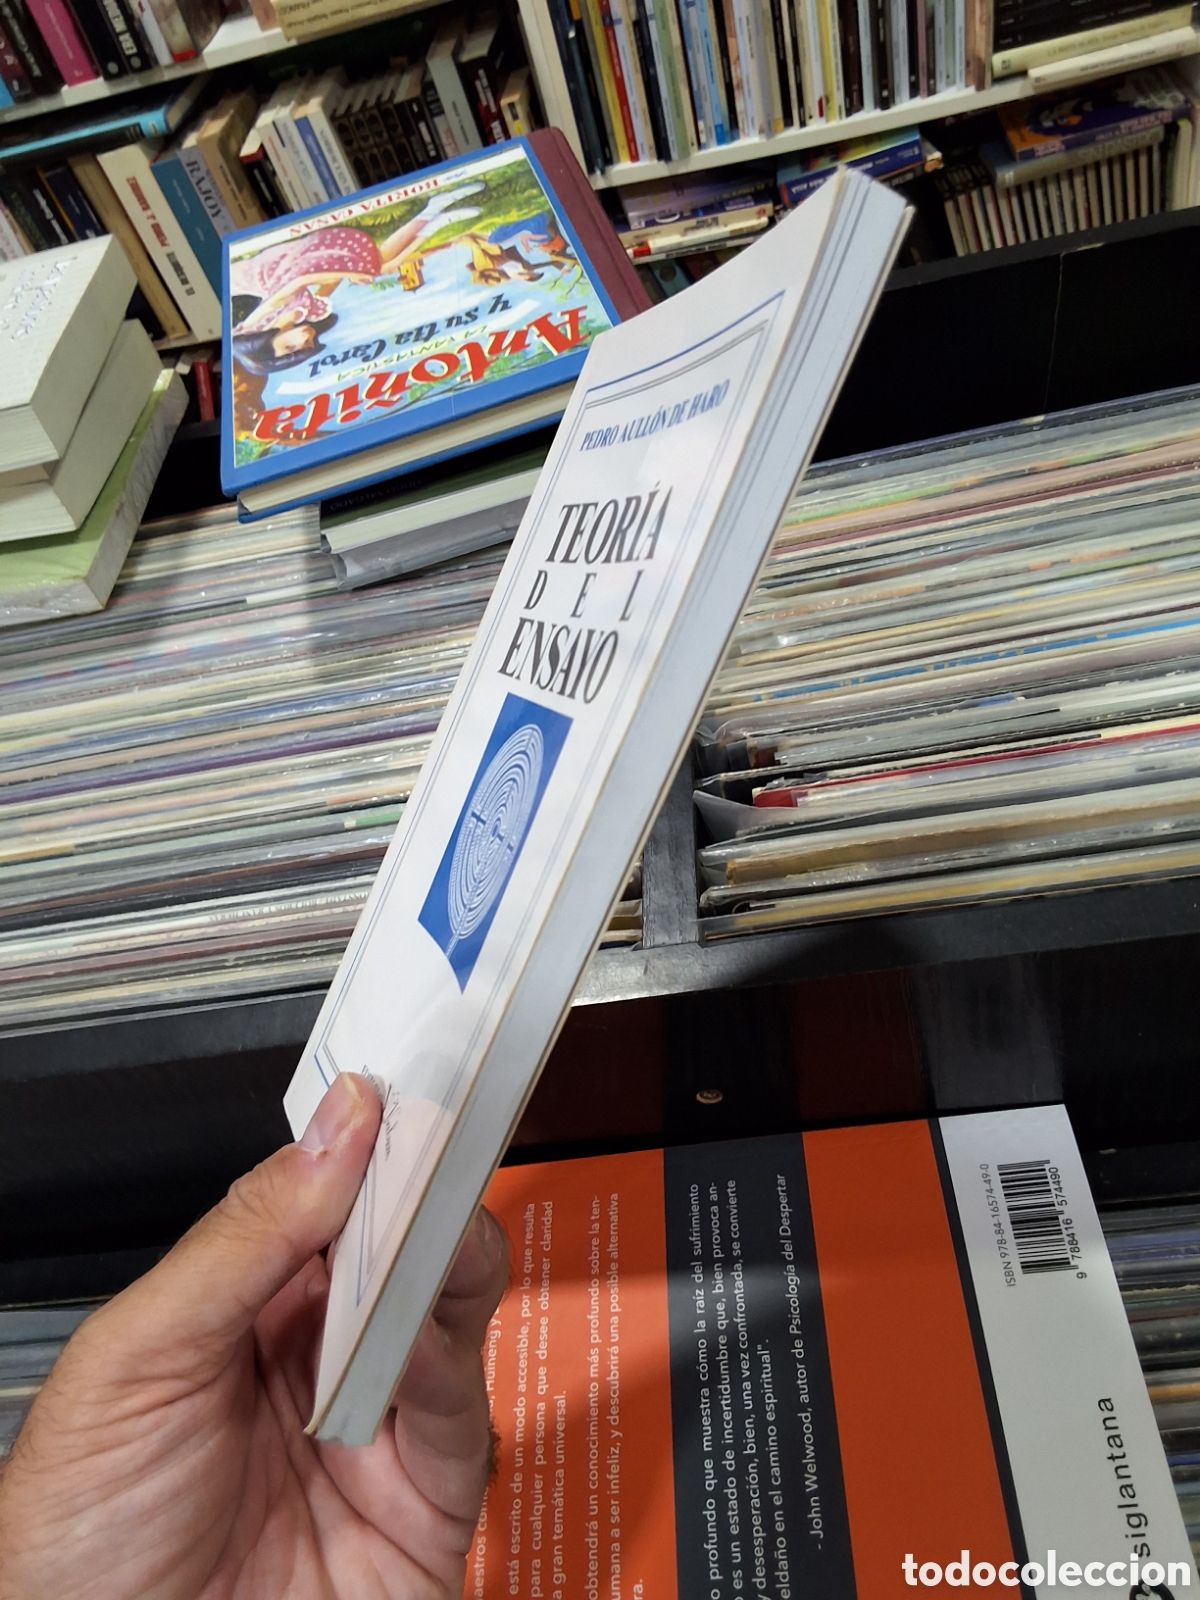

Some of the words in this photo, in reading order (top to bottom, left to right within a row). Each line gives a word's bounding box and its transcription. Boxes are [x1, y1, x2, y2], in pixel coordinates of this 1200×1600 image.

[186, 159, 222, 218] RAJOY
[445, 307, 479, 328] su
[488, 293, 511, 315] y
[253, 305, 592, 442] Antoñita
[309, 339, 386, 378] Carol
[580, 424, 619, 452] PEDRO
[617, 405, 669, 444] AULLÓN
[666, 399, 690, 430] DE
[688, 378, 731, 419] HARO
[545, 481, 673, 565] TEORÍA
[497, 617, 619, 704] ENSAYO
[592, 1195, 600, 1220] ten-
[709, 1182, 717, 1201] an-
[777, 1174, 793, 1236] Despertar
[1048, 1167, 1068, 1206] 574490
[523, 1203, 535, 1246] resulta
[540, 1201, 553, 1251] claridad
[588, 1222, 599, 1235] la
[607, 1193, 619, 1259] alternativa
[689, 1184, 702, 1255] sufrimiento
[726, 1180, 739, 1238] convierte
[979, 1163, 1007, 1258] 978-84-16574-49-0
[711, 1206, 725, 1258] provoca
[731, 1240, 740, 1256] se
[780, 1240, 794, 1261] del
[1062, 1218, 1082, 1260] 788416
[523, 1247, 535, 1273] que
[588, 1237, 599, 1274] sobre
[691, 1262, 703, 1283] del
[1003, 1261, 1016, 1287] ISBN
[1076, 1271, 1087, 1280] 9
[520, 1277, 531, 1290] lo
[538, 1258, 550, 1310] obtener
[607, 1263, 622, 1313] posible
[712, 1263, 724, 1293] bien
[784, 1264, 801, 1334] Psicología
[491, 1318, 502, 1330] y
[521, 1294, 532, 1318] por
[587, 1279, 602, 1344] profundo
[716, 1297, 729, 1330] que,
[731, 1259, 748, 1349] confrontada,
[536, 1316, 548, 1360] desee
[610, 1316, 619, 1342] una
[694, 1320, 706, 1333] la
[484, 1331, 501, 1391] Huineng
[516, 1321, 530, 1392] accesible,
[586, 1347, 598, 1378] más
[697, 1338, 709, 1380] cómo
[740, 1352, 750, 1378] vez
[791, 1339, 805, 1358] de
[538, 1366, 550, 1395] que
[606, 1345, 620, 1426] descubrirá
[716, 1334, 734, 1444] incertidumbre
[742, 1382, 752, 1410] una
[796, 1362, 810, 1404] autor
[513, 1397, 526, 1443] modo
[535, 1403, 547, 1466] persona
[554, 1391, 567, 1464] universal.
[587, 1382, 598, 1489] conocimiento
[611, 1429, 623, 1439] y
[700, 1387, 712, 1451] muestra
[743, 1414, 756, 1454] bien,
[515, 1448, 523, 1467] un
[607, 1443, 621, 1494] infeliz,
[722, 1450, 735, 1471] de
[766, 1425, 779, 1485] camino
[797, 1407, 818, 1492] Welwood,
[510, 1472, 522, 1493] de
[704, 1459, 718, 1491] que
[1097, 1398, 1150, 1558] siglantana
[529, 1473, 546, 1550] cualquier
[552, 1468, 564, 1540] temática
[589, 1494, 598, 1516] un
[611, 1498, 620, 1524] ser
[724, 1477, 740, 1535] estado
[768, 1490, 783, 1505] el
[808, 1496, 823, 1539] John
[509, 1498, 522, 1554] escrito
[611, 1528, 620, 1538] a
[703, 1499, 723, 1580] profundo
[745, 1458, 766, 1590] desesperación,
[774, 1511, 784, 1532] en
[474, 1536, 486, 1600] aestros
[553, 1545, 566, 1585] gran
[584, 1520, 598, 1600] obtendrá
[732, 1541, 742, 1563] un
[774, 1537, 791, 1600] eldaño
[507, 1559, 519, 1595] está
[531, 1559, 543, 1598] para
[733, 1570, 743, 1590] es
